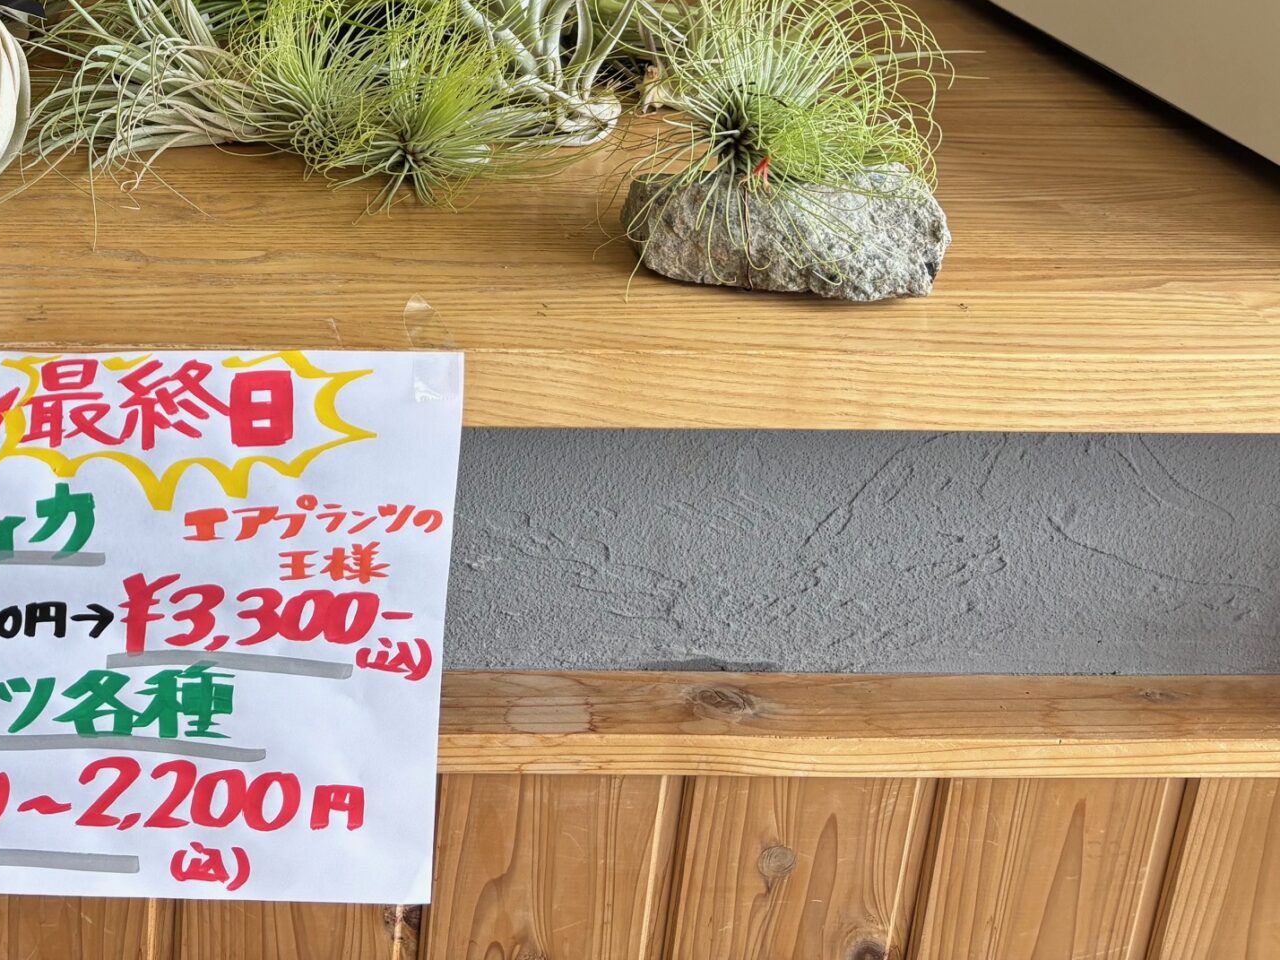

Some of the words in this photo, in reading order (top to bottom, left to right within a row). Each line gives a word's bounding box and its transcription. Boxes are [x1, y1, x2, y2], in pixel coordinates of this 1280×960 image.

[183, 494, 444, 542] エアプランツの
[278, 541, 391, 584] 王様
[170, 846, 251, 892] (込)
